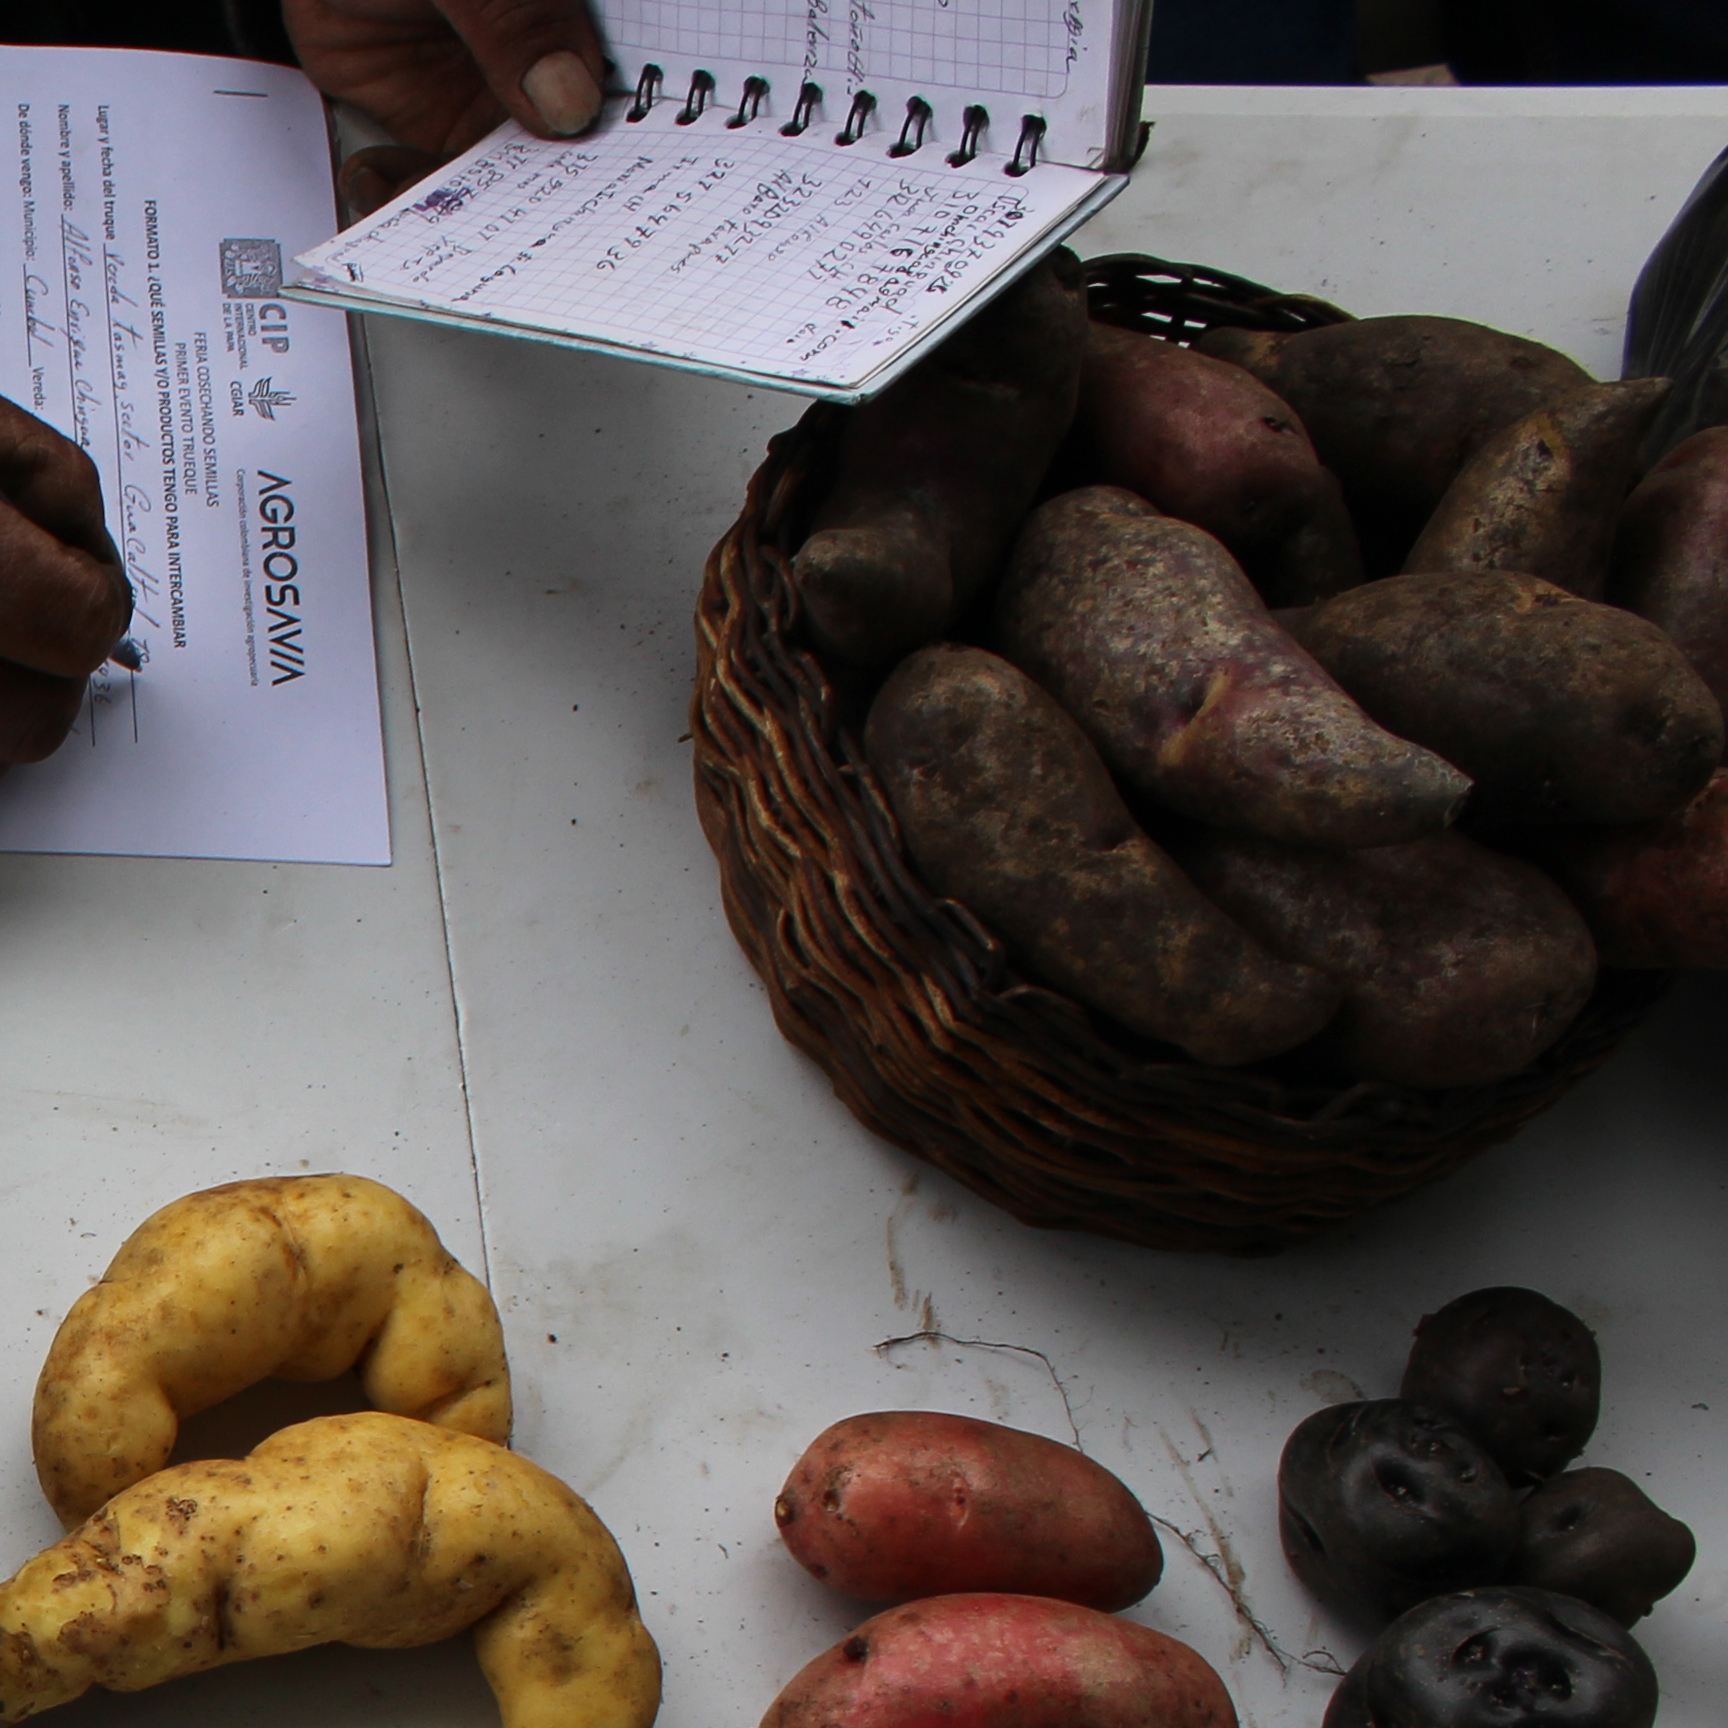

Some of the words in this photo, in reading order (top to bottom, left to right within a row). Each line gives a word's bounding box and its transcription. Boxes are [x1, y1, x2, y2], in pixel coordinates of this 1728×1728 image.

[19, 104, 29, 118] De
[58, 105, 73, 148] Nombre
[96, 105, 112, 134] Lugar
[20, 120, 33, 155] dónde
[58, 150, 70, 158] y
[18, 157, 33, 198] vengo:
[100, 148, 116, 178] fecha
[60, 160, 76, 211] apellido:
[104, 181, 117, 196] del
[22, 200, 39, 260] Municipio:
[101, 198, 118, 240] truque
[144, 200, 160, 258] FORMATO
[148, 262, 160, 273] 1.
[148, 276, 168, 307] ¿QUÉ
[223, 304, 232, 314] DE
[151, 310, 170, 364] SEMILLAS
[224, 316, 234, 327] LA
[234, 303, 248, 370] INTERNACIONAL
[246, 303, 256, 336] CENTRO
[259, 304, 290, 354] CIP
[194, 332, 209, 364] FERIA
[225, 330, 236, 352] PAPA
[154, 368, 172, 390] Y/O
[174, 342, 190, 384] PRIMER
[30, 367, 46, 410] Vereda:
[196, 366, 214, 445] COSECHANDO
[230, 381, 244, 416] CGIAR
[157, 392, 177, 464] PRODUCTOS
[178, 388, 192, 433] EVENTO
[180, 437, 198, 495] TRUEQUE
[202, 448, 220, 507] SEMILLAS
[162, 468, 180, 513] TENGO
[236, 470, 249, 519] Corporación
[166, 516, 181, 549] PARA
[240, 520, 252, 566] colombiana
[242, 567, 252, 578] de
[257, 470, 305, 686] AGROSAVIA
[169, 552, 187, 648] INTERCAMBIAR
[242, 580, 256, 634] investigación
[244, 634, 258, 686] agropecuaria
